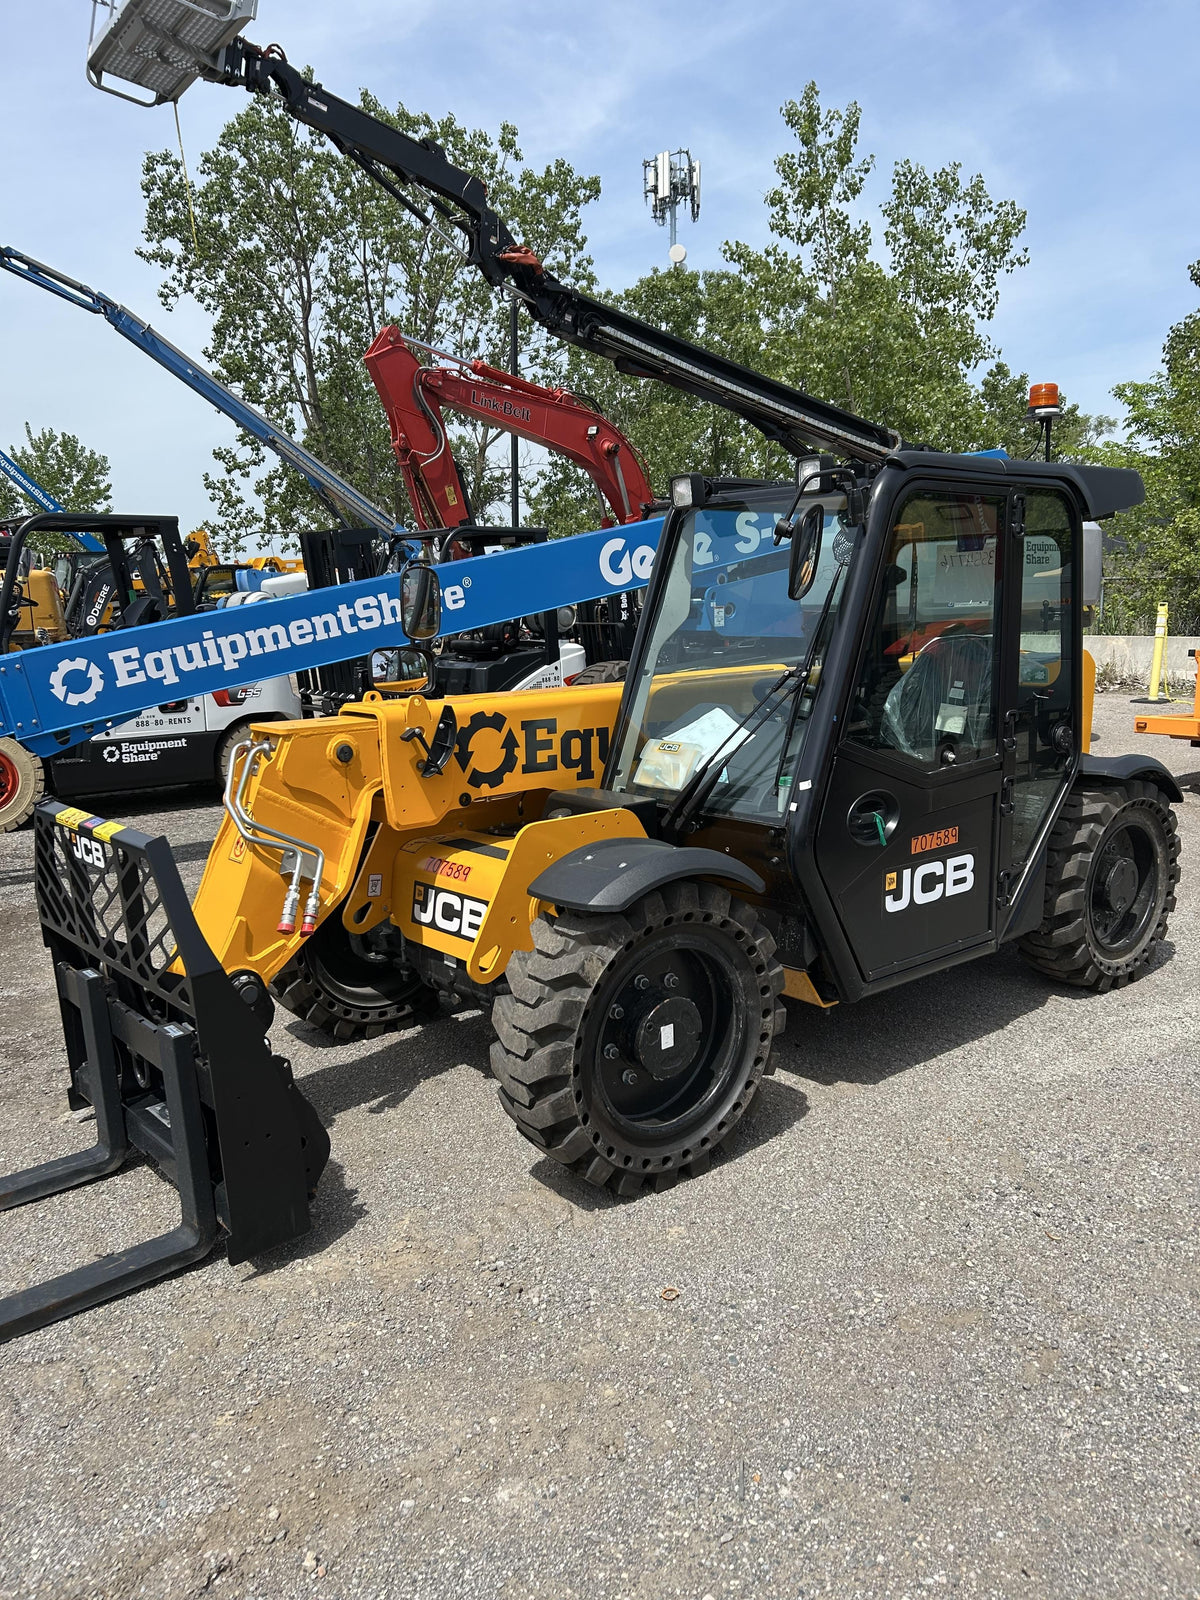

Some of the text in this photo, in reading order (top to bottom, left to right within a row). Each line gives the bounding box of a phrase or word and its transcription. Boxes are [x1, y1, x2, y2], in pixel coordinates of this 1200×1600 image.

[471, 390, 530, 422] Link-Belt
[1026, 553, 1050, 565] Share
[91, 583, 111, 617] DEERE
[121, 738, 187, 755] Equipment
[122, 751, 161, 764] Share
[659, 743, 680, 752] JCB
[73, 835, 105, 868] JCB
[911, 828, 958, 853] 707589
[426, 857, 471, 881] 707589
[885, 854, 975, 912] JCB
[414, 889, 489, 939] JCB
